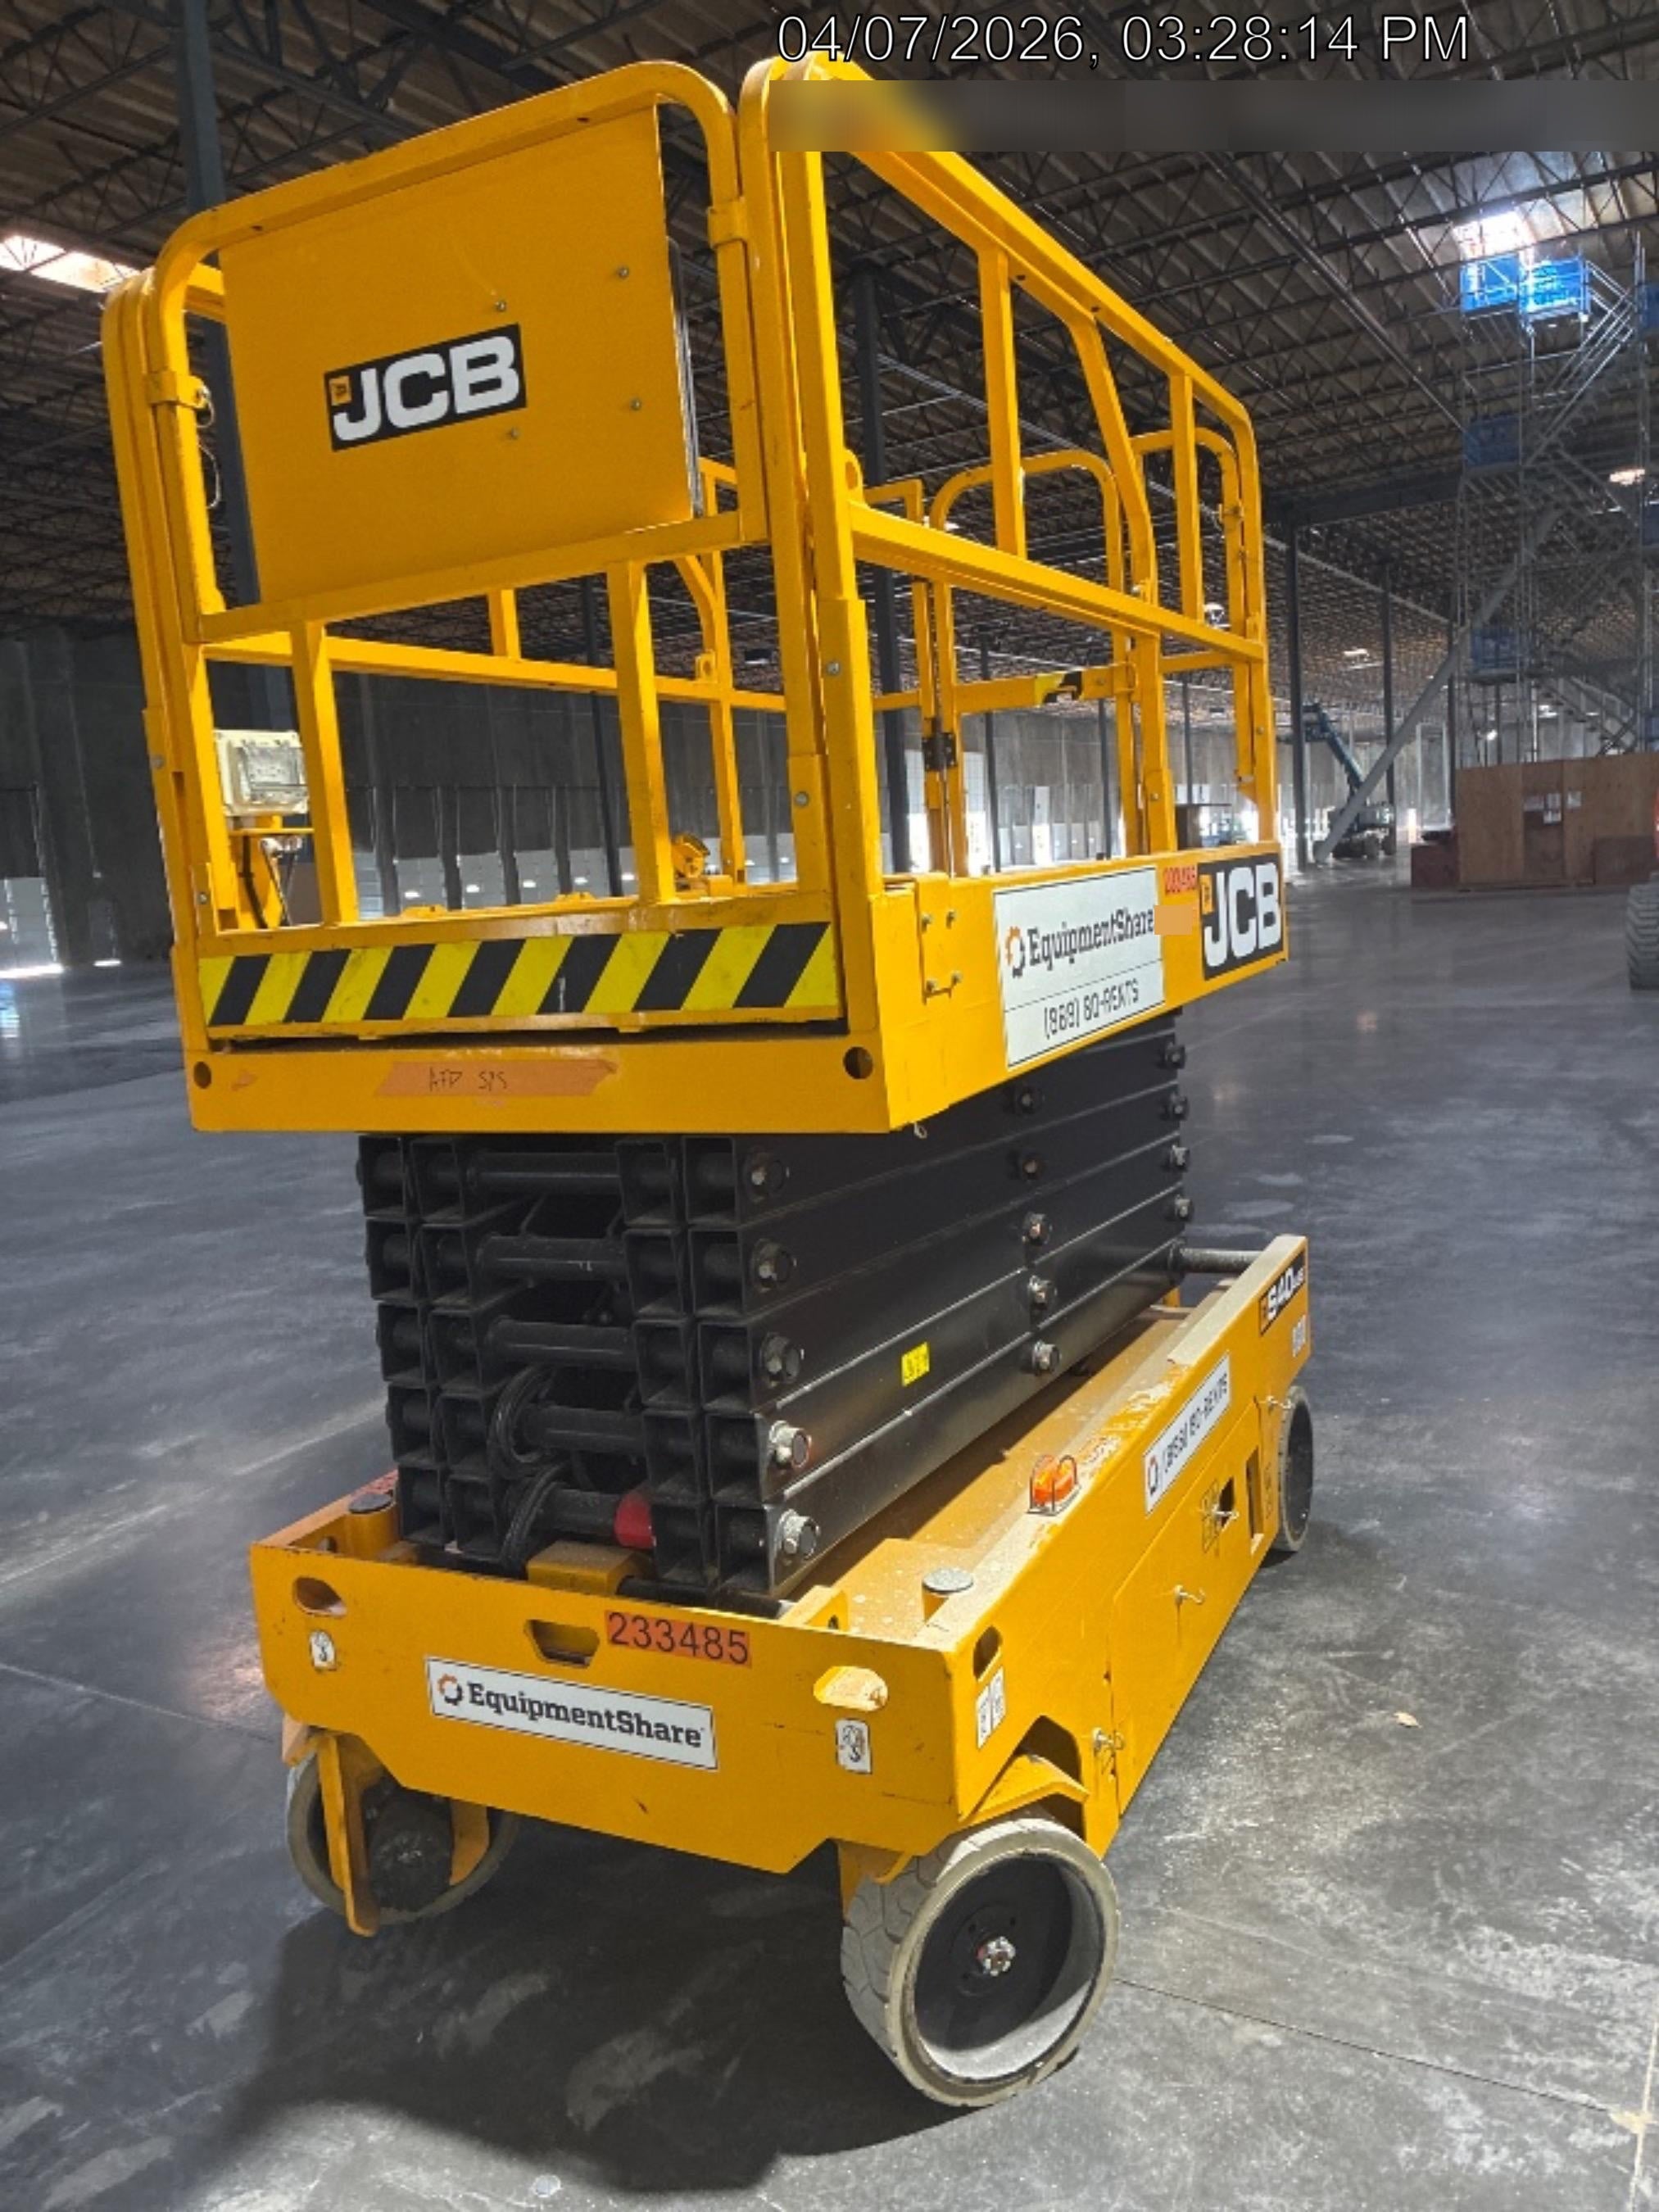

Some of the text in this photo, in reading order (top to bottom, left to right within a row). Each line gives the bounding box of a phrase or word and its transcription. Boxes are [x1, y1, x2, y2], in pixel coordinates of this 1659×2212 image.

[333, 336, 520, 441] JCB
[1027, 907, 1154, 972] EquipmentShare
[1203, 862, 1281, 968] JCB
[608, 1611, 749, 1666] 233485
[467, 1680, 703, 1748] EquipmentShare
